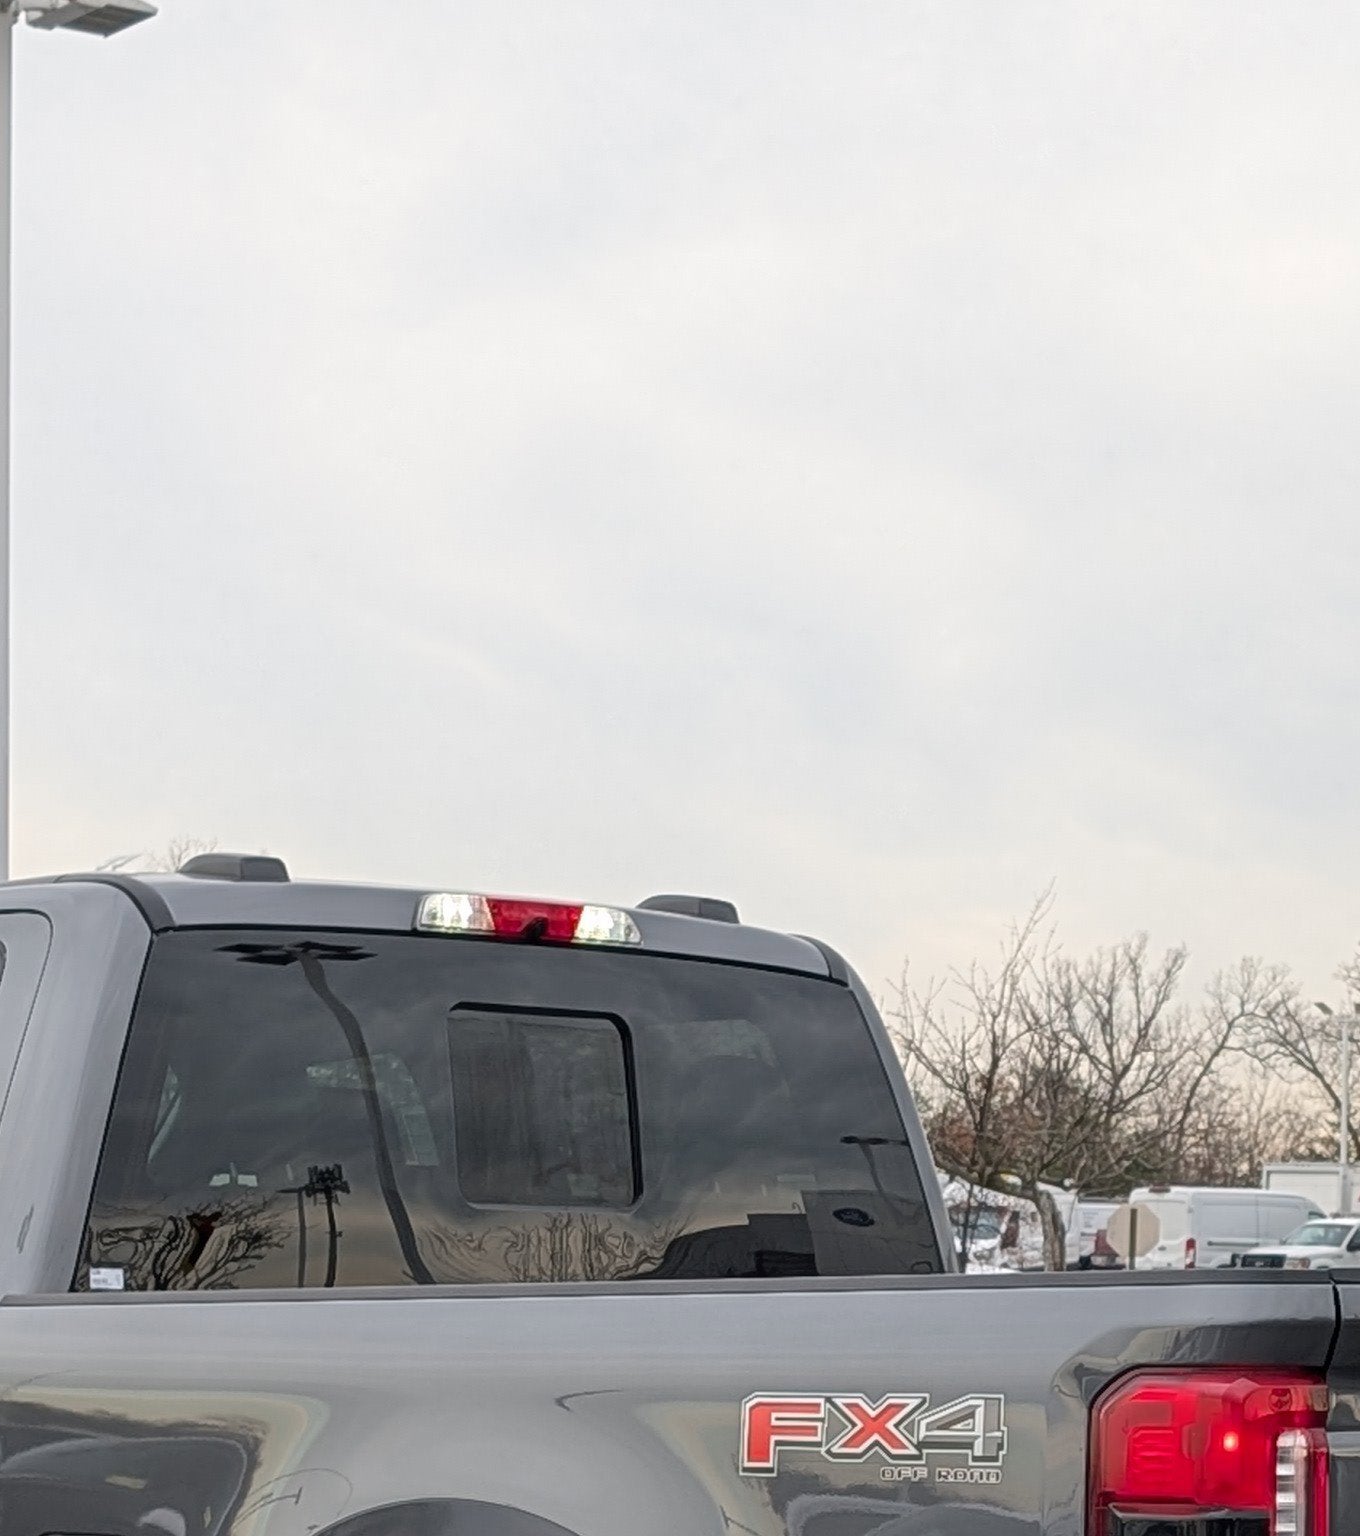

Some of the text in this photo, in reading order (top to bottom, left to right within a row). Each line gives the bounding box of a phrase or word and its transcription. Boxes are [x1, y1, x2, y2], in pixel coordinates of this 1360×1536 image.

[740, 1391, 1007, 1476] FX4
[880, 1466, 1003, 1484] OFF ROAD
